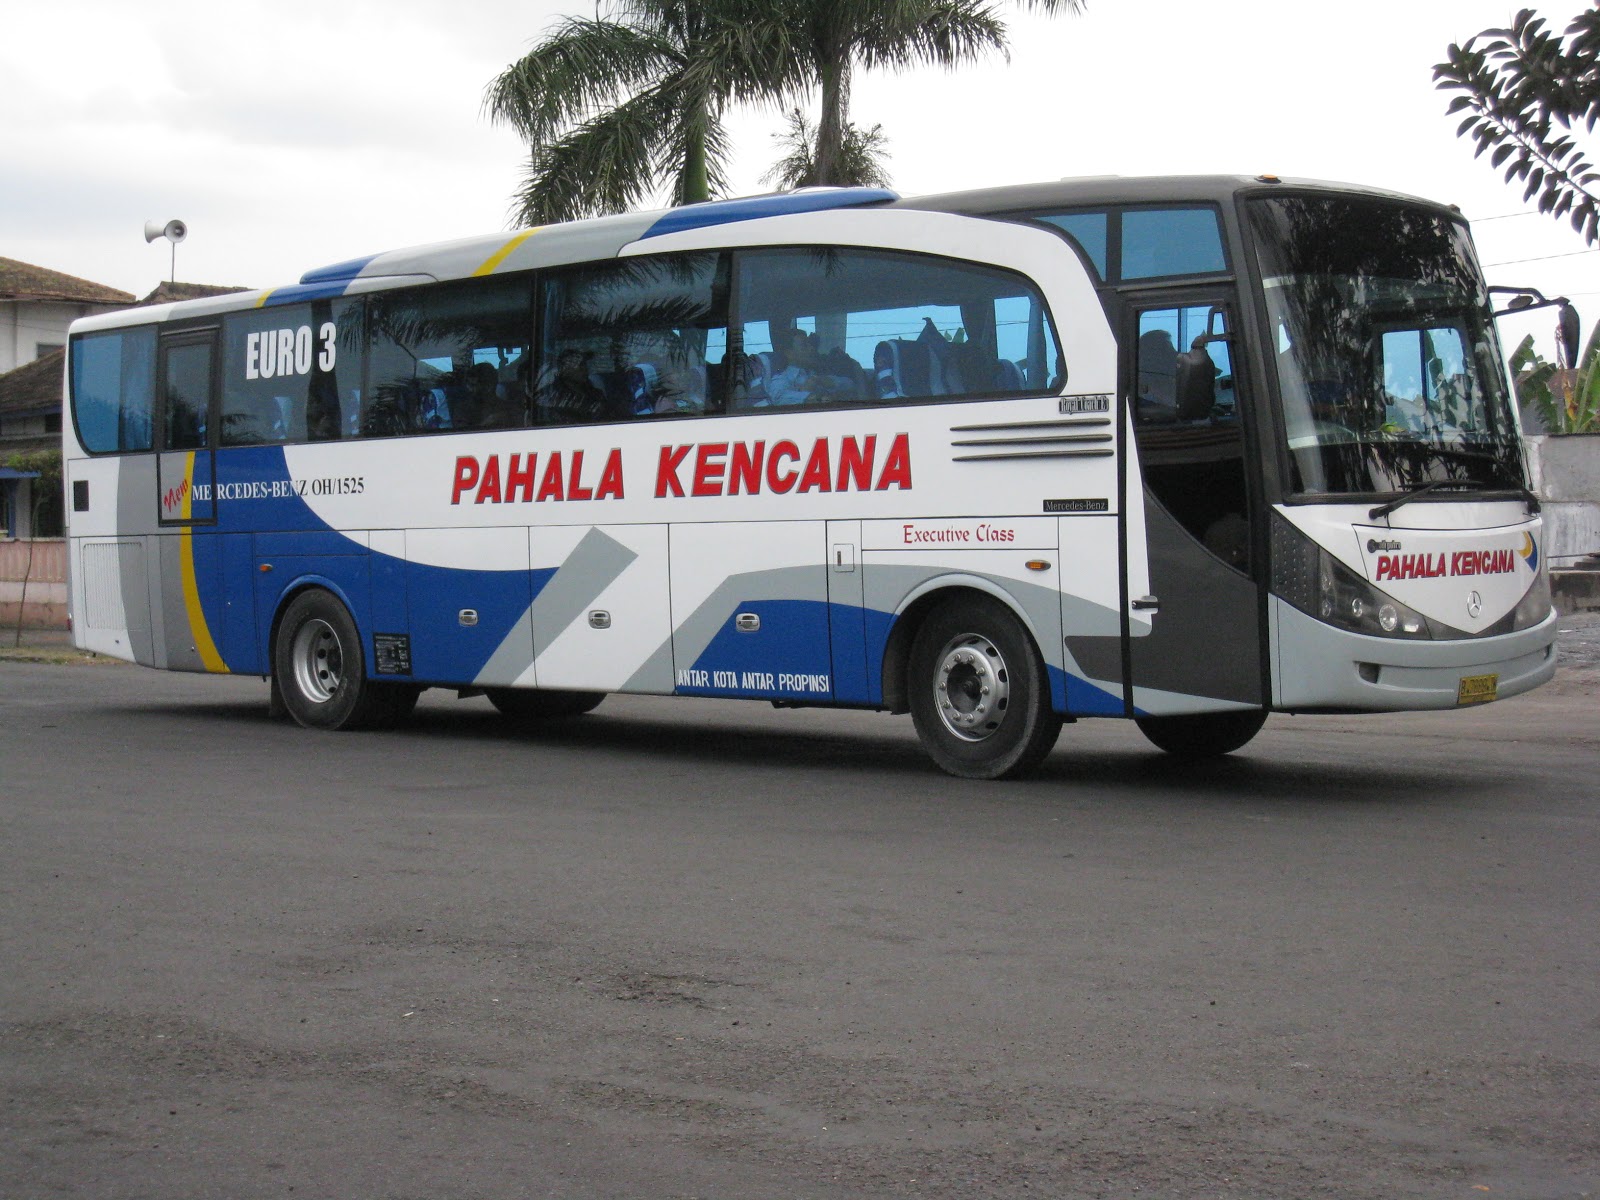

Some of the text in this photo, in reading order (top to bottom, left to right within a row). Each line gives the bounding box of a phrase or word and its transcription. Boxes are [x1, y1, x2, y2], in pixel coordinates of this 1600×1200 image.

[246, 321, 337, 380] EURO 3
[451, 431, 913, 505] PAHALA KENCANA
[163, 478, 189, 513] New
[191, 476, 365, 501] MERCEDES-BENZ OH/1525
[1045, 500, 1106, 511] Mercedes-Benz
[903, 524, 1015, 544] Executive Class
[1376, 549, 1515, 581] PAHALA KENCANA
[678, 669, 830, 693] ANTAR KOTA ANTAR PROPINSI
